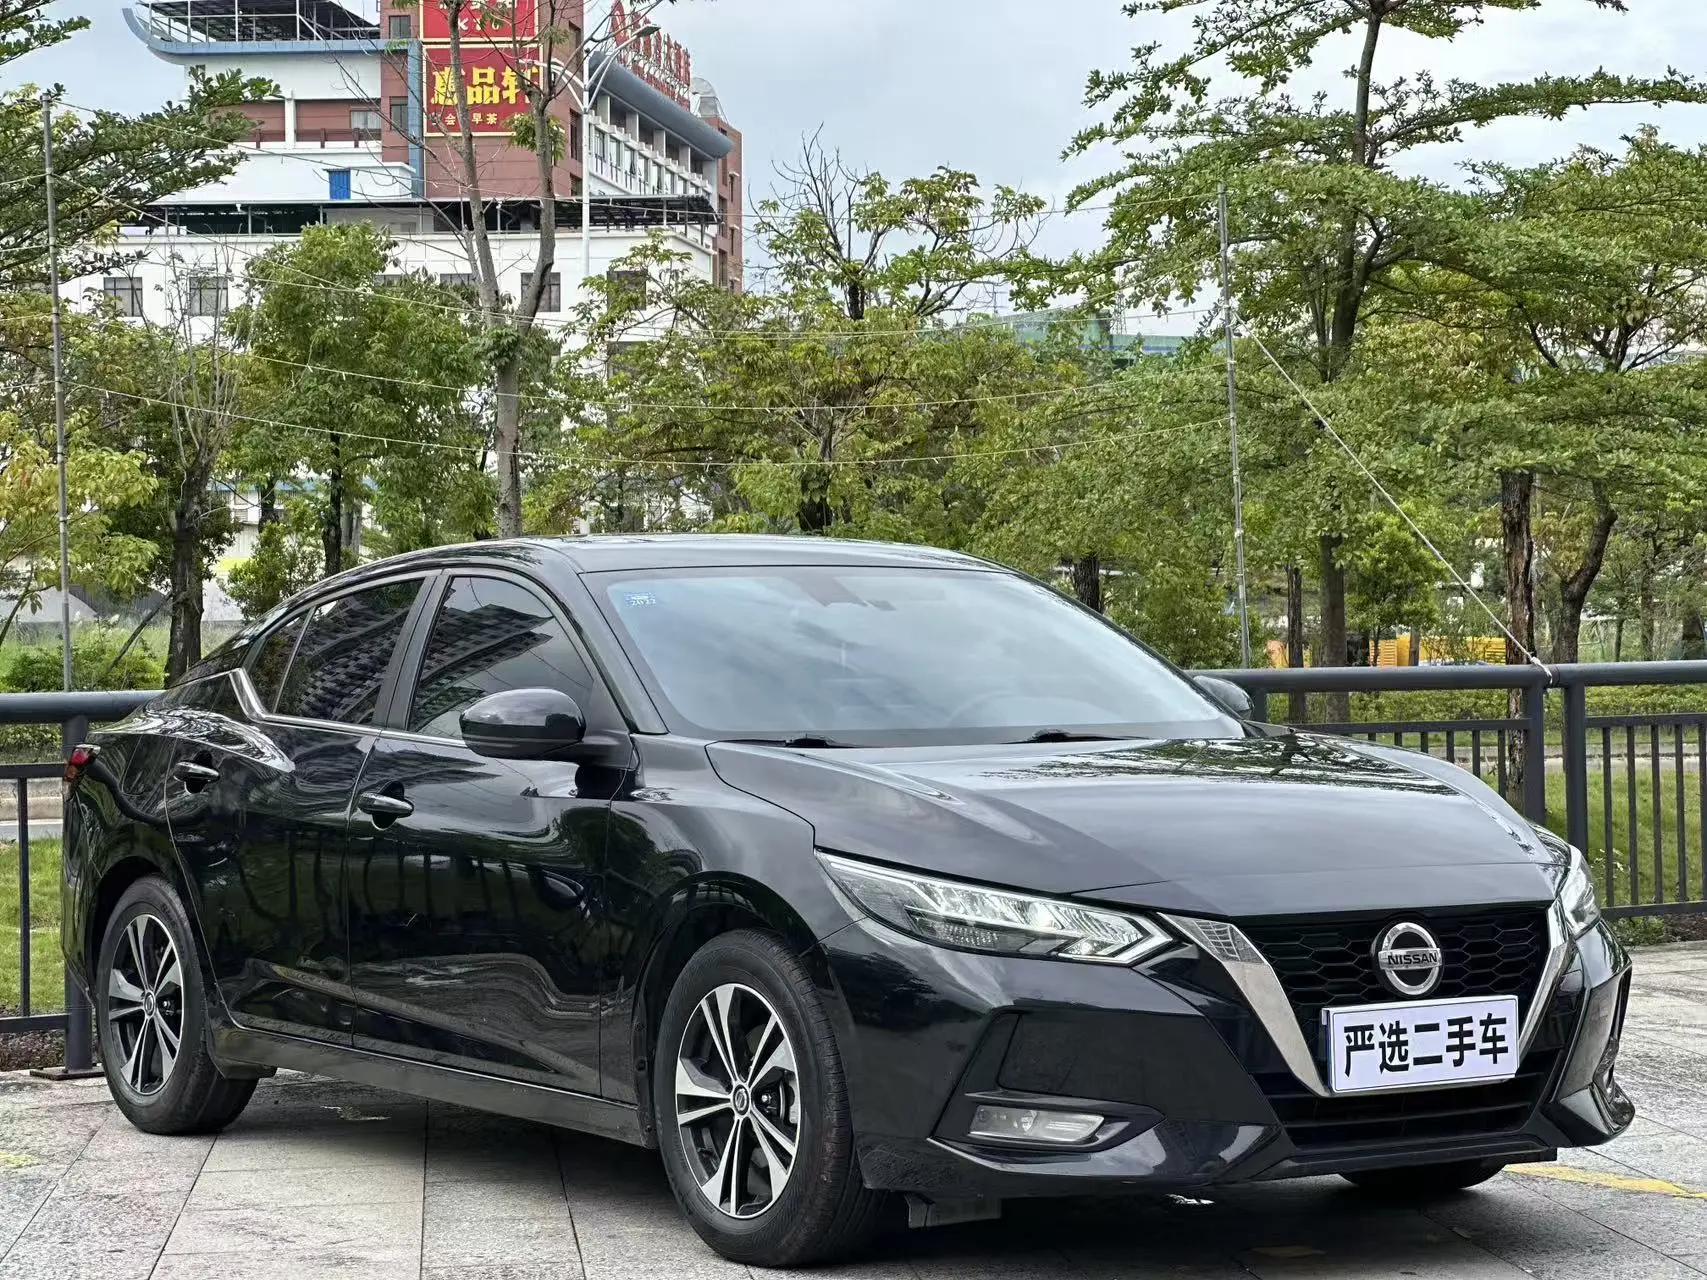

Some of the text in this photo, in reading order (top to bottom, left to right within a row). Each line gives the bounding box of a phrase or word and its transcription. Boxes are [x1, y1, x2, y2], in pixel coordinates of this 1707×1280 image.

[1387, 952, 1438, 965] NISSAN
[1343, 1012, 1509, 1078] 严选二手车
